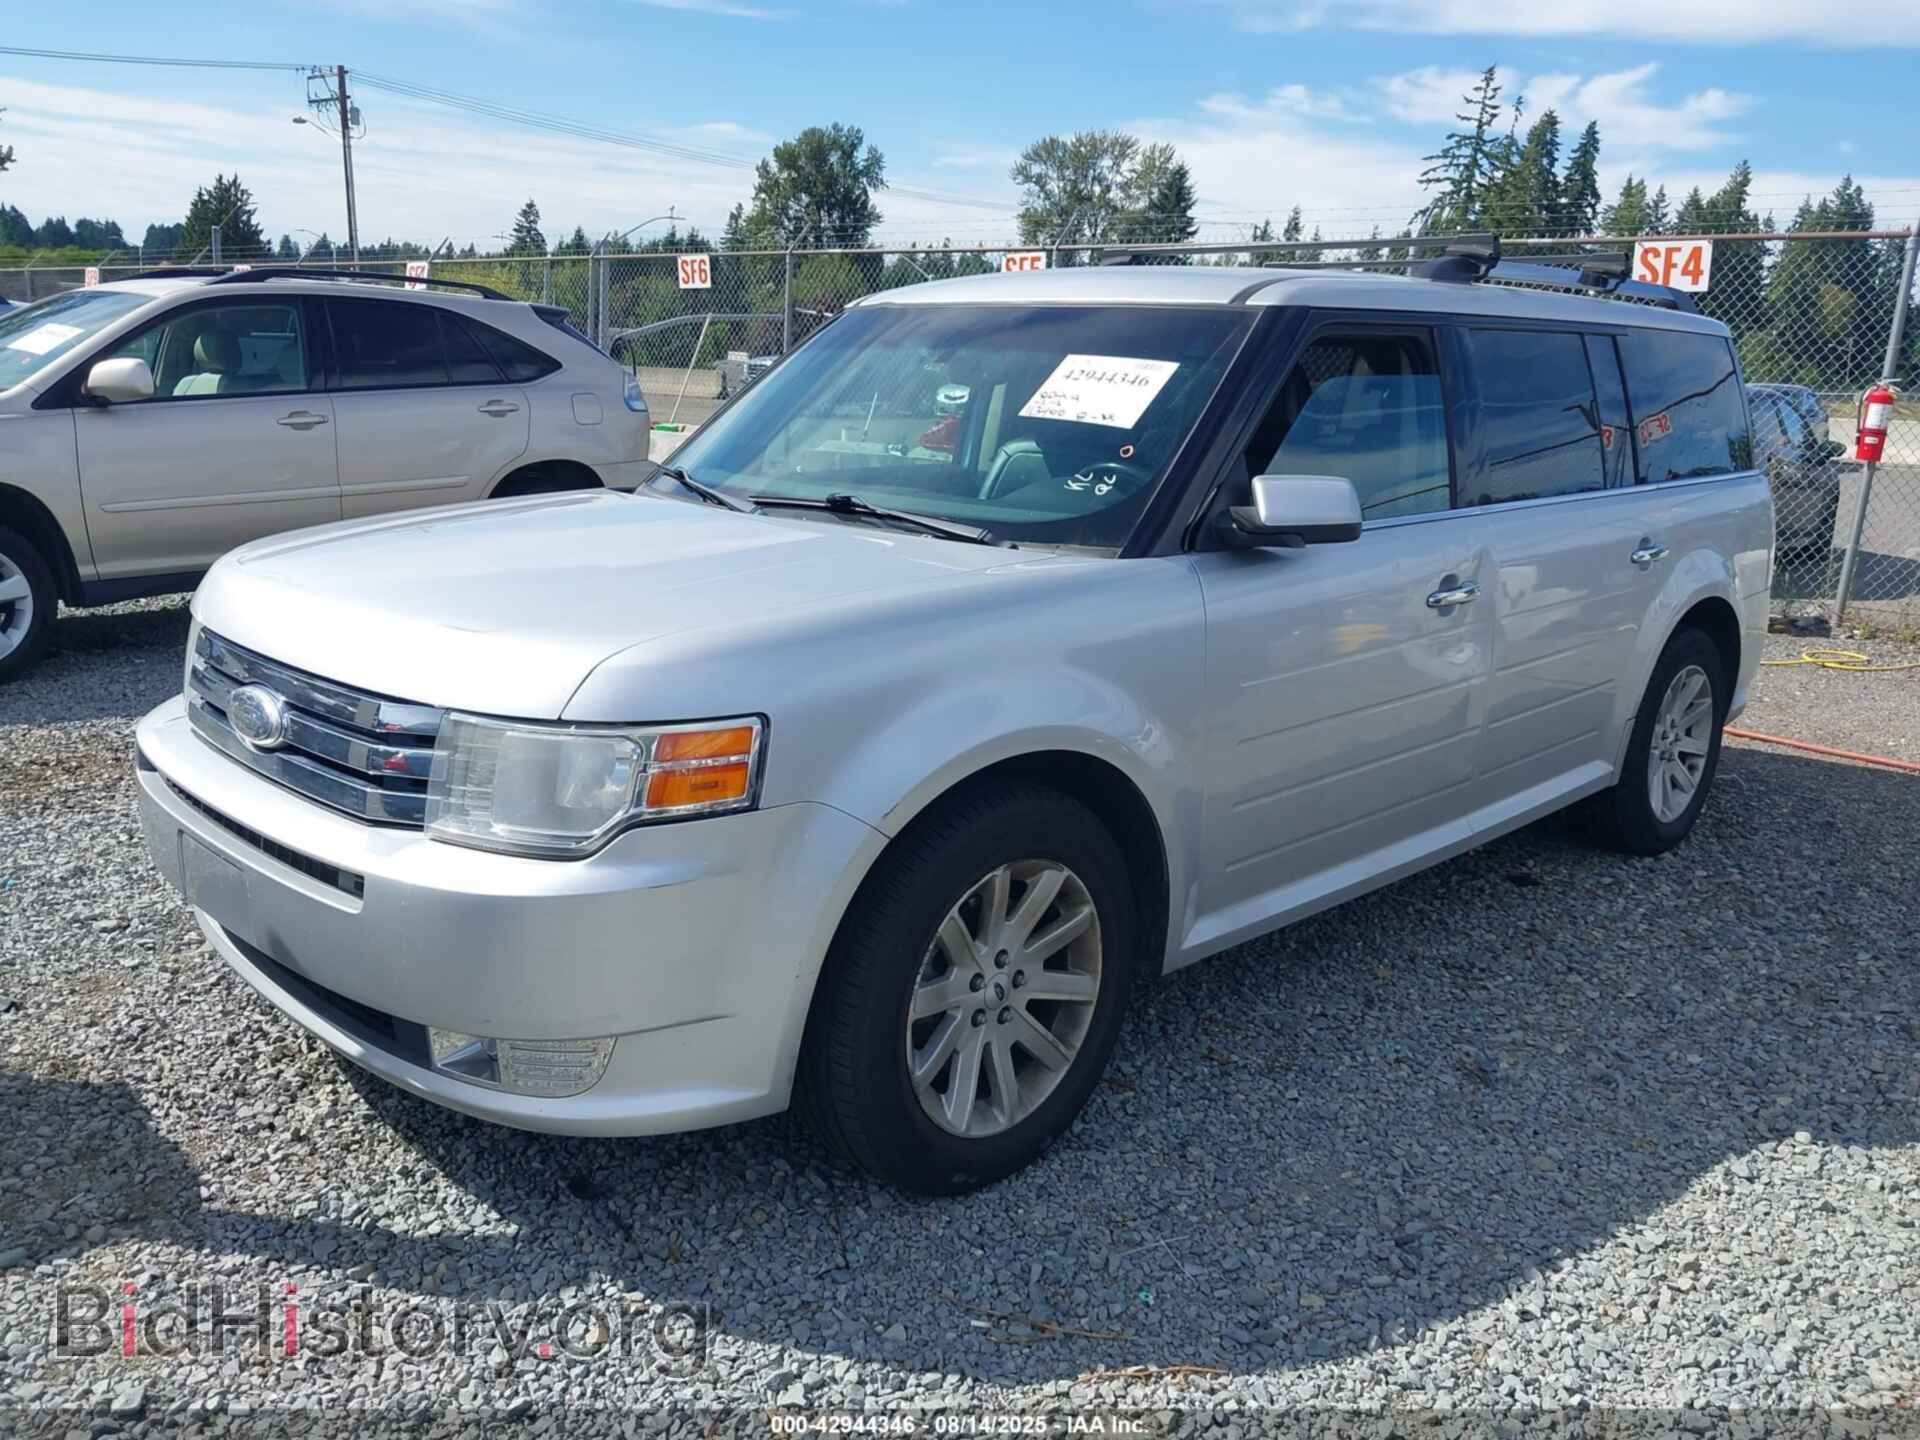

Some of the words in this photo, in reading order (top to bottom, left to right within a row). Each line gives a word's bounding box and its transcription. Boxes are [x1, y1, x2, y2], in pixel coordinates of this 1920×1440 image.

[681, 259, 708, 284] SF6
[1638, 246, 1704, 288] SF4
[1063, 369, 1150, 388] 42944346
